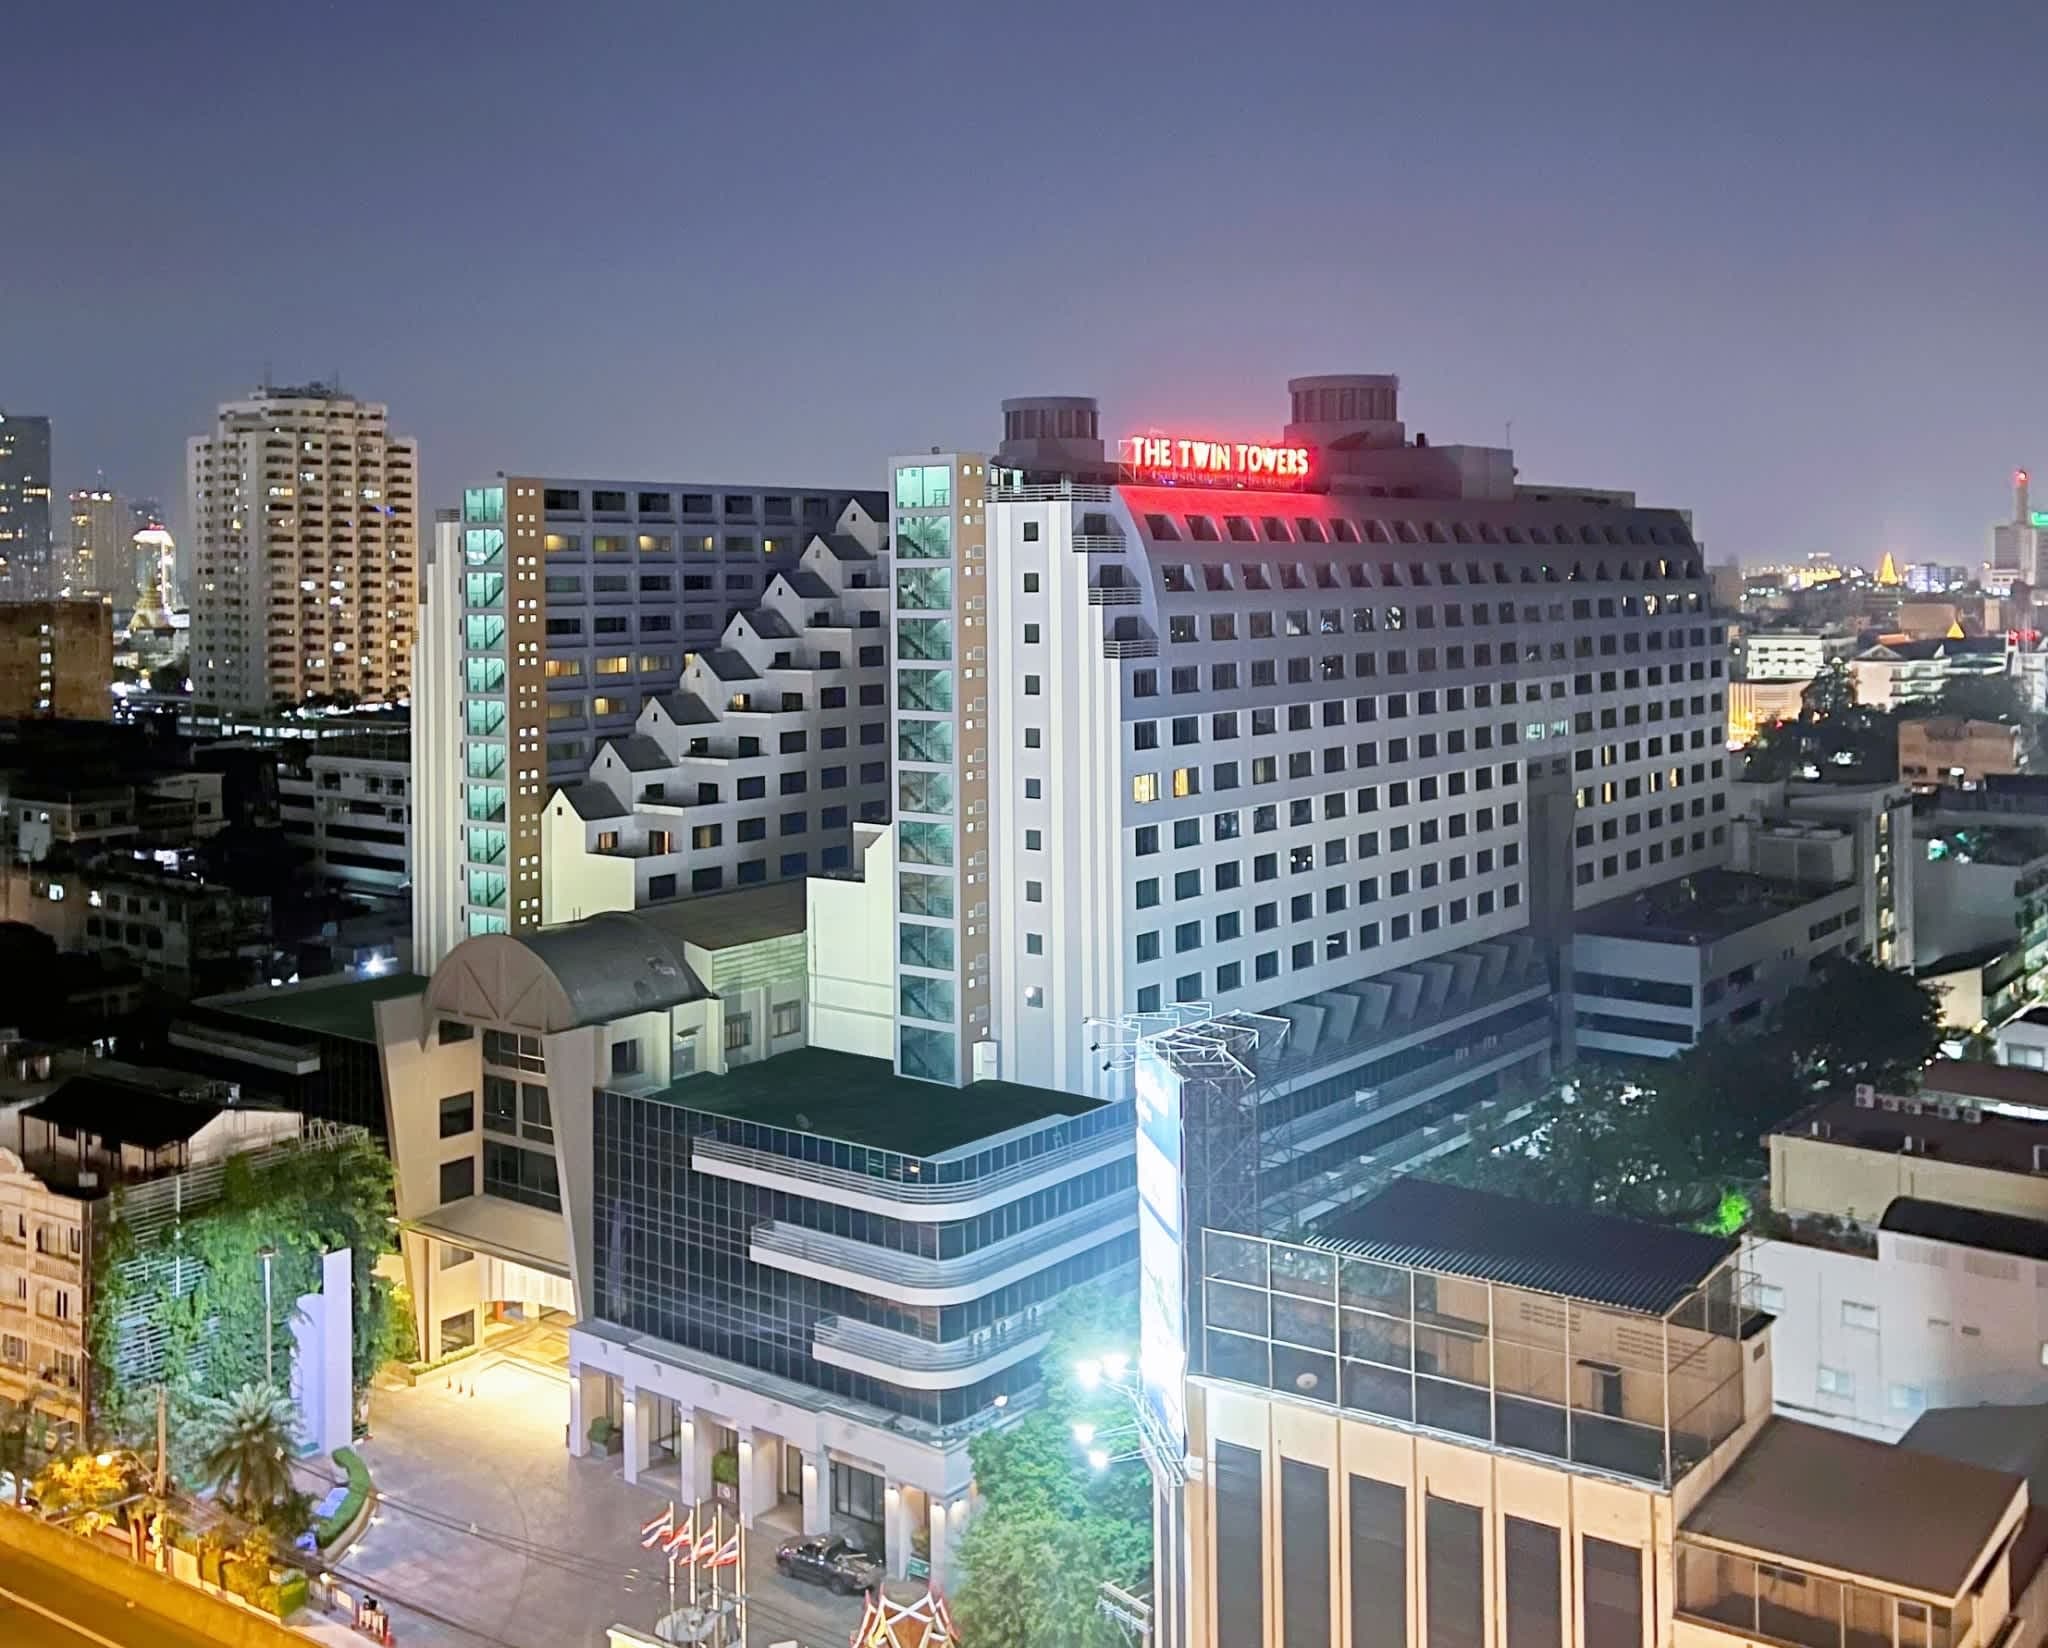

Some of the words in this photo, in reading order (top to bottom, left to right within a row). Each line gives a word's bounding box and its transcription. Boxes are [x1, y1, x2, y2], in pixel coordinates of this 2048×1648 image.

[1132, 437, 1172, 466] THE
[1178, 440, 1231, 471] TWIN
[1237, 445, 1309, 475] TOWERS
